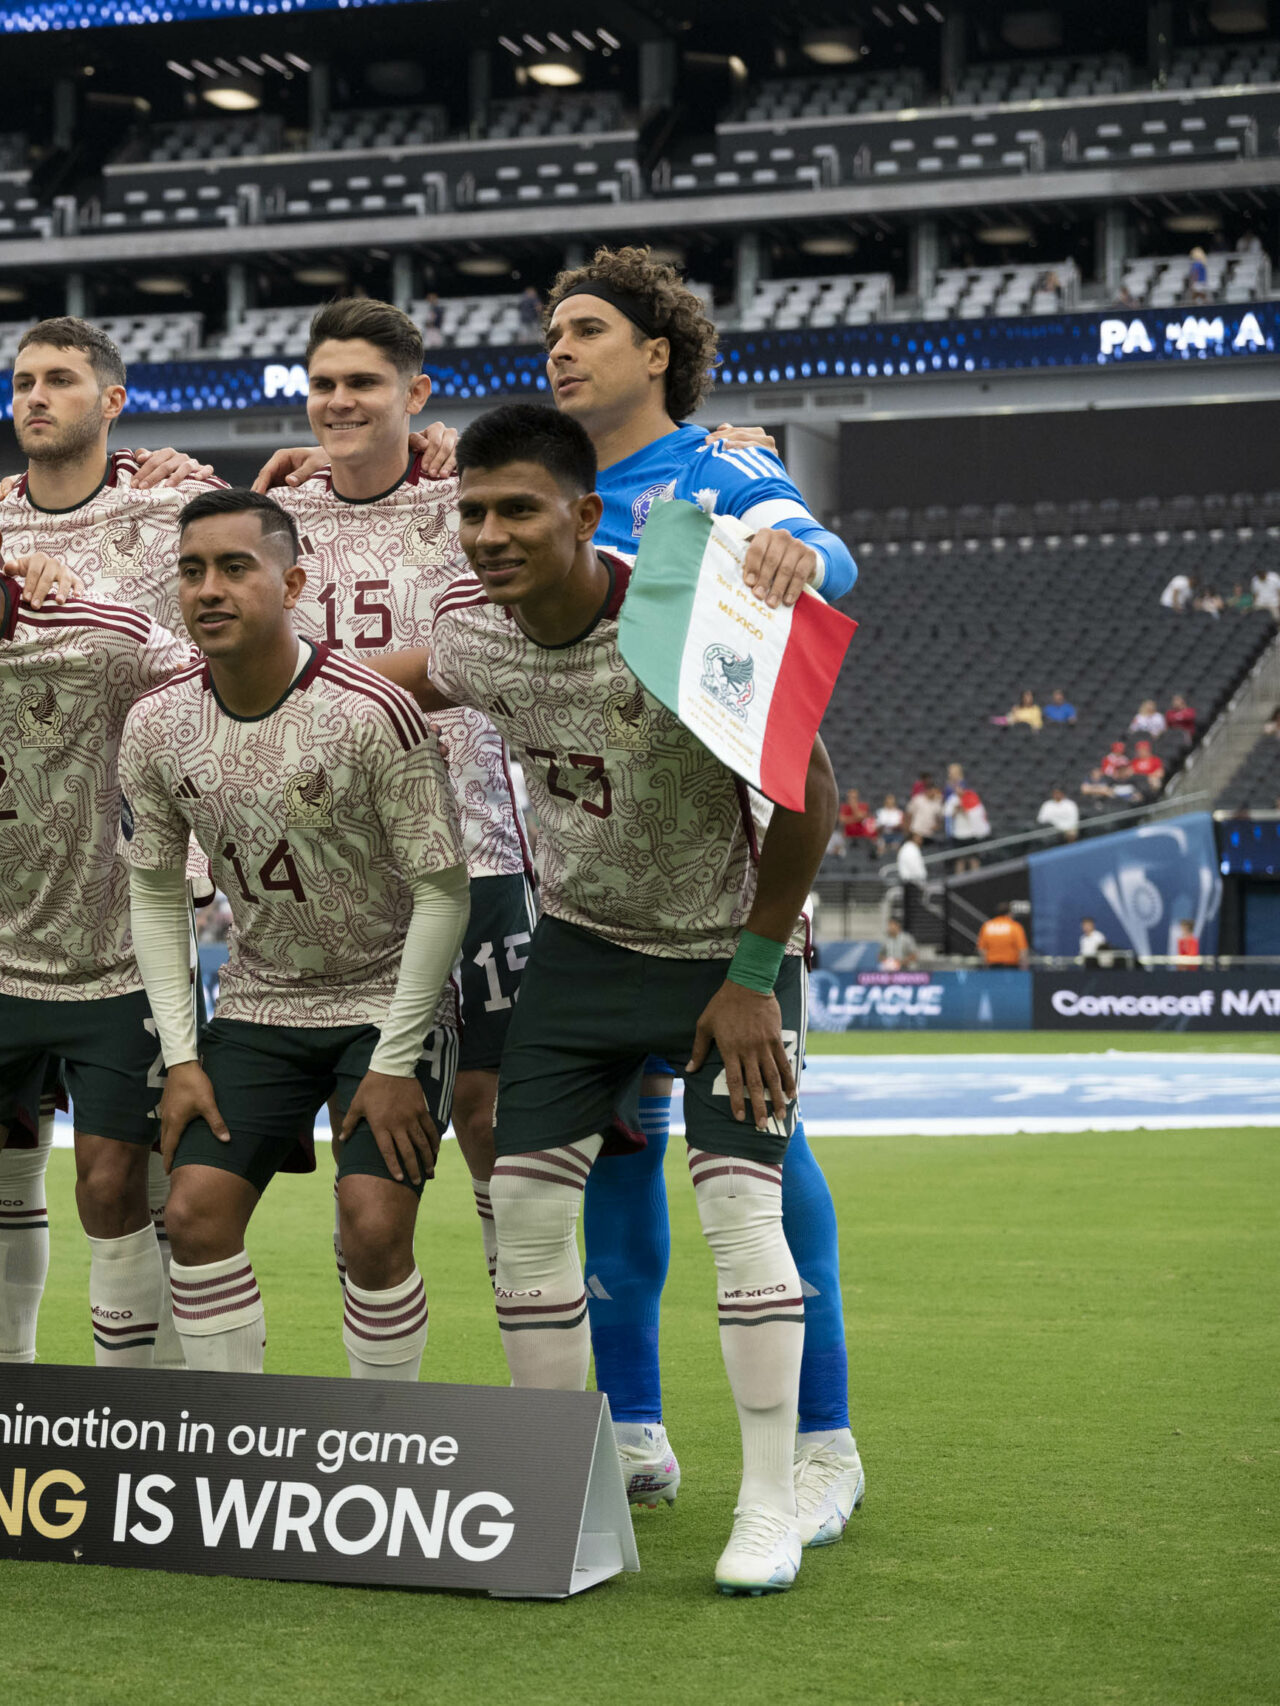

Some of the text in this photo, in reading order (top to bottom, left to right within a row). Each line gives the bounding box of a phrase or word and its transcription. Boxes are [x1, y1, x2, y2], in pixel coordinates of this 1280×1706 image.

[317, 580, 393, 649] 15
[222, 839, 307, 904] 14
[828, 985, 944, 1015] LEAGUE
[1051, 989, 1215, 1016] Concacaf
[724, 1284, 786, 1298] MÉXICO
[178, 1410, 214, 1453] in
[228, 1425, 306, 1457] our
[317, 1429, 459, 1473] game
[113, 1474, 176, 1545] IS
[195, 1477, 515, 1562] WRONG
